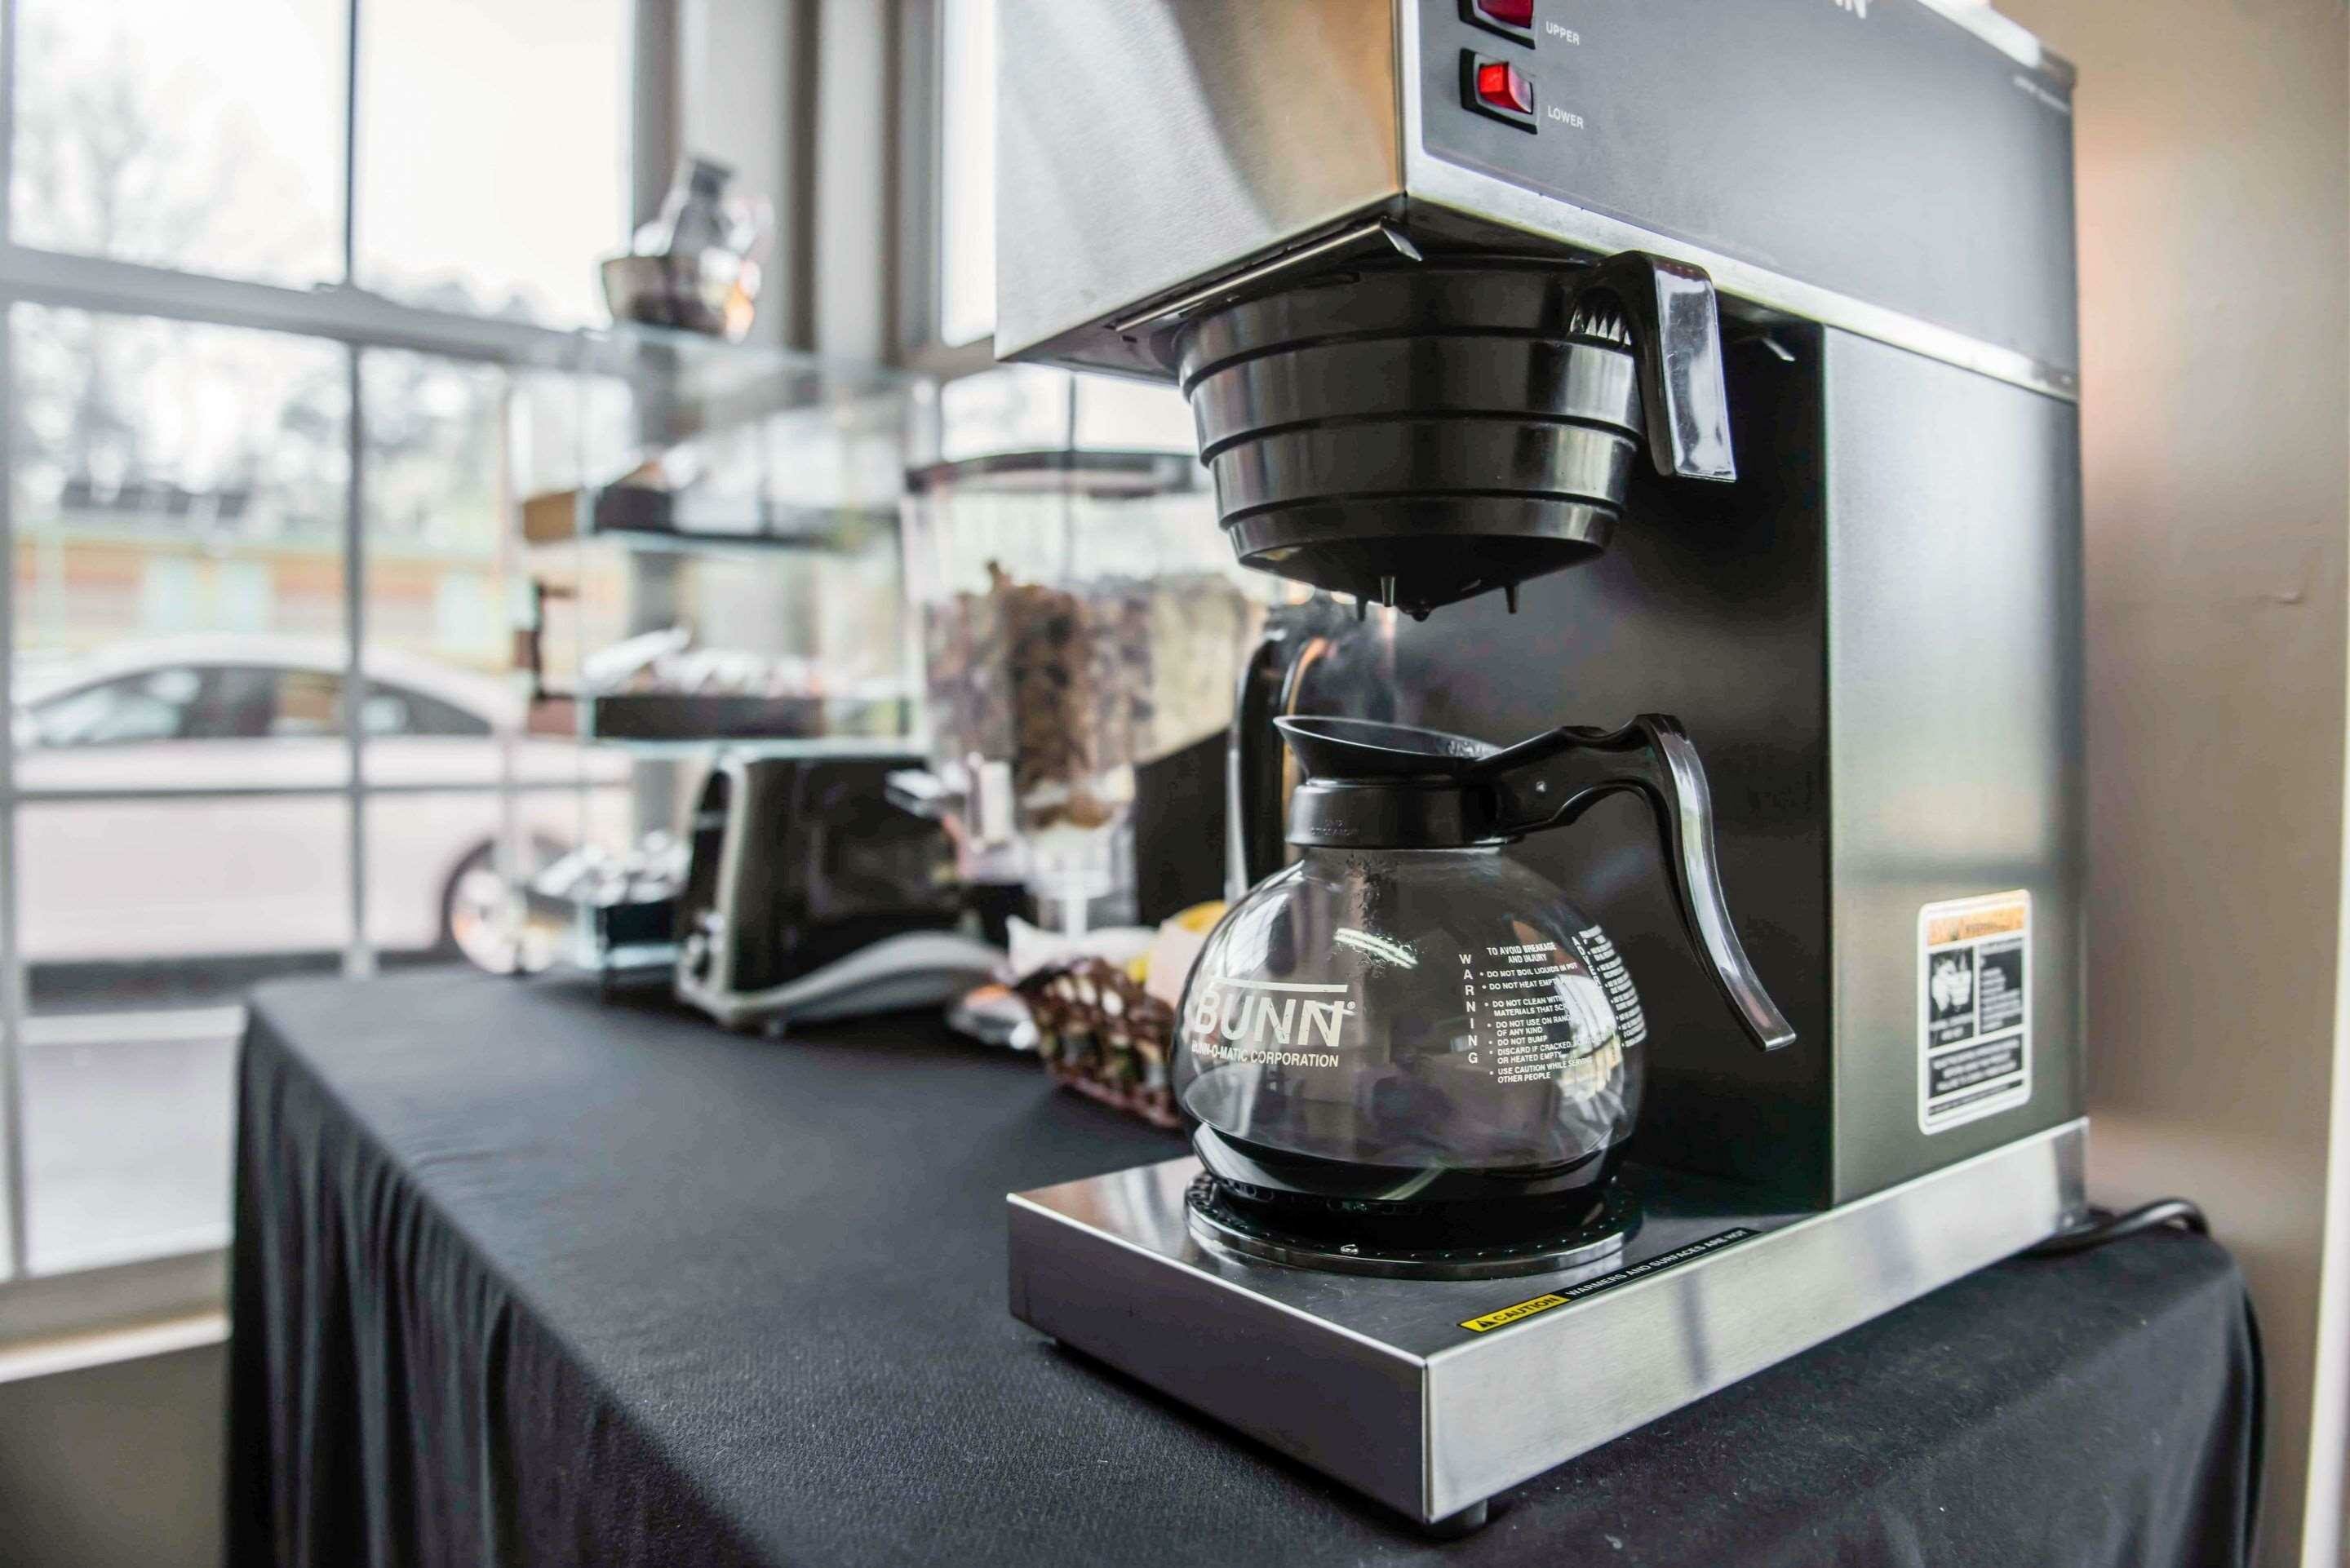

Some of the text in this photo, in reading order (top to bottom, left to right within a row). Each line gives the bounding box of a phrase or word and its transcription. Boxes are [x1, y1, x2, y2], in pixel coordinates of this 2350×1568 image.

[1545, 20, 1580, 46] UPPER
[1547, 105, 1584, 130] LOWER
[1486, 941, 1557, 955] TO AVOID BREAKAGE
[1508, 953, 1547, 963] AND INJURY
[1501, 969, 1515, 977] NOT
[1516, 968, 1534, 977] BOIL
[1534, 965, 1559, 975] LIQUIDS
[1559, 963, 1567, 972] IN
[1502, 981, 1519, 990] NOT
[1519, 980, 1537, 988] HEAT
[1458, 953, 1479, 1064] WARNING
[1505, 999, 1522, 1008] NOT
[1523, 997, 1546, 1005] CLEAN
[1493, 1007, 1535, 1017] MATERIALS
[1536, 1004, 1554, 1014] THAT
[1496, 1021, 1508, 1029] DO
[1509, 1019, 1524, 1028] NOT
[1526, 1017, 1541, 1026] USE
[1541, 1017, 1553, 1025] ON
[1509, 1028, 1524, 1036] ANY
[1525, 1025, 1543, 1034] KIND
[1510, 1036, 1526, 1045] NOT
[1528, 1034, 1548, 1043] BUMP
[1191, 1039, 1339, 1068] BUNN-O-MATIC CORPORATION
[1497, 1046, 1531, 1056] DISCARD
[1532, 1045, 1539, 1053] IF
[1497, 1051, 1562, 1065] OR HEATED EMPTY
[1497, 1067, 1514, 1075] USE
[1514, 1063, 1545, 1074] CAUTION
[1546, 1061, 1567, 1070] WHILE
[1497, 1071, 1551, 1083] OTHER PEOPLE
[1492, 1296, 1559, 1322] CAUTION
[1566, 1273, 1627, 1297] WARMERS
[1625, 1265, 1652, 1277] AND
[1649, 1245, 1706, 1267] SURFACES
[1704, 1237, 1728, 1248] ARE
